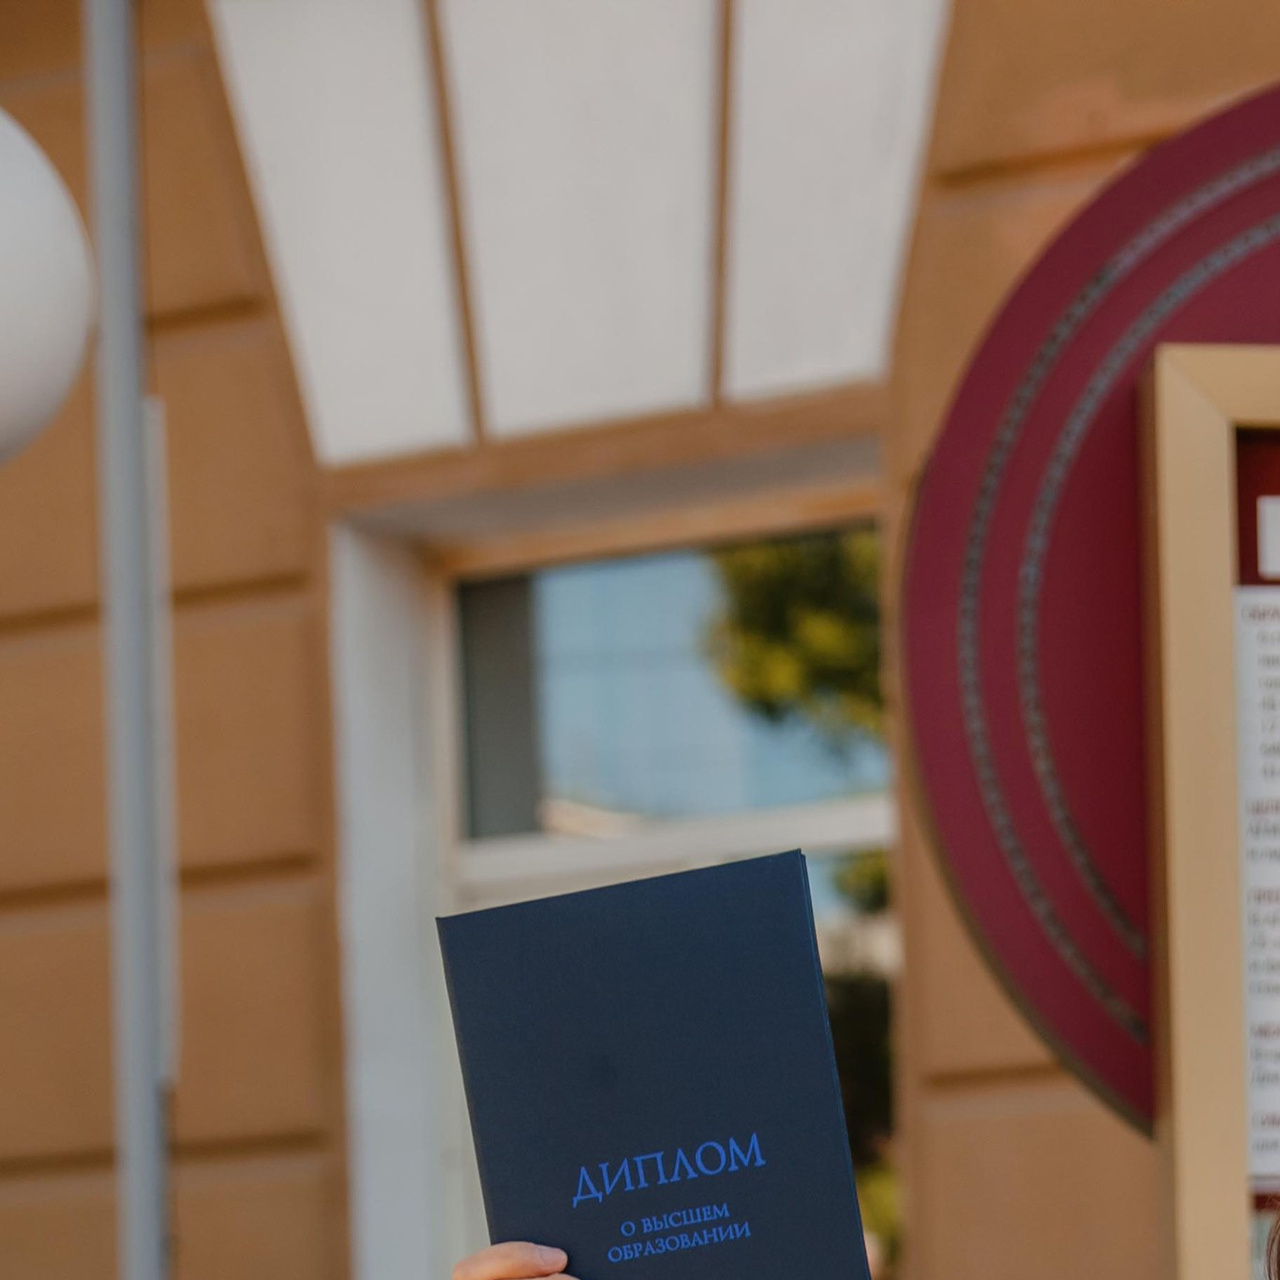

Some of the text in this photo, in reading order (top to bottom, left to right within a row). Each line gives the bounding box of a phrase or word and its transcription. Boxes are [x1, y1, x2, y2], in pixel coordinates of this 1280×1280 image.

[572, 1132, 766, 1208] ДИПЛОМ
[620, 1202, 731, 1237] О ВЫСШЕМ
[607, 1221, 752, 1263] ОБРАЗОВАНИИ
